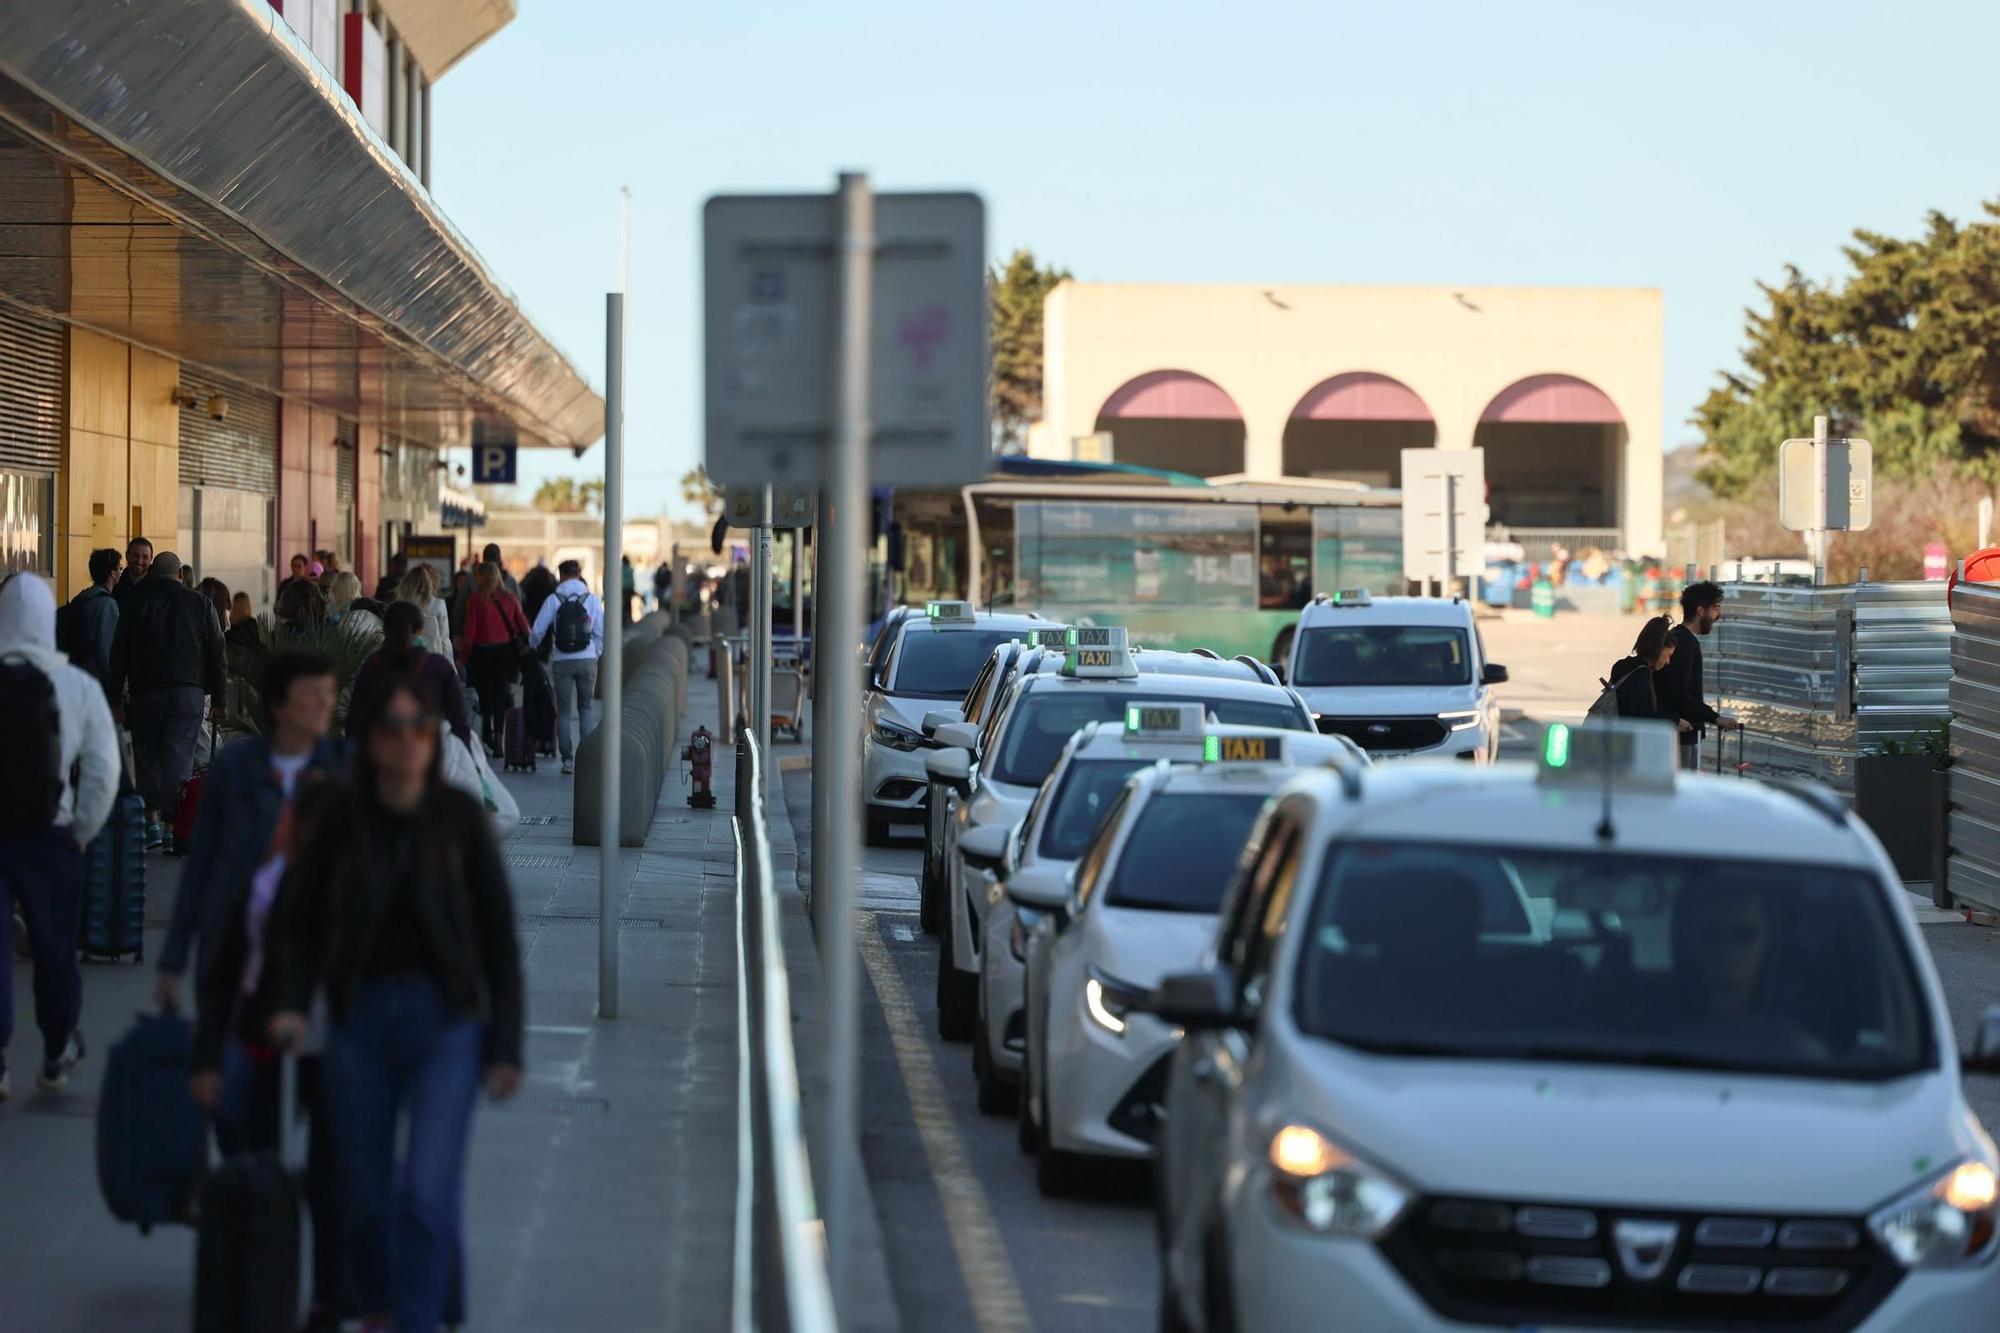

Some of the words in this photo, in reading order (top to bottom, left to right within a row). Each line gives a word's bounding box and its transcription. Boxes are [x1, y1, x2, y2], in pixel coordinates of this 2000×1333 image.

[1041, 631, 1065, 644] TAX
[1080, 630, 1108, 644] TAXI
[1080, 651, 1109, 665] TAXI
[1223, 738, 1265, 760] TAXI
